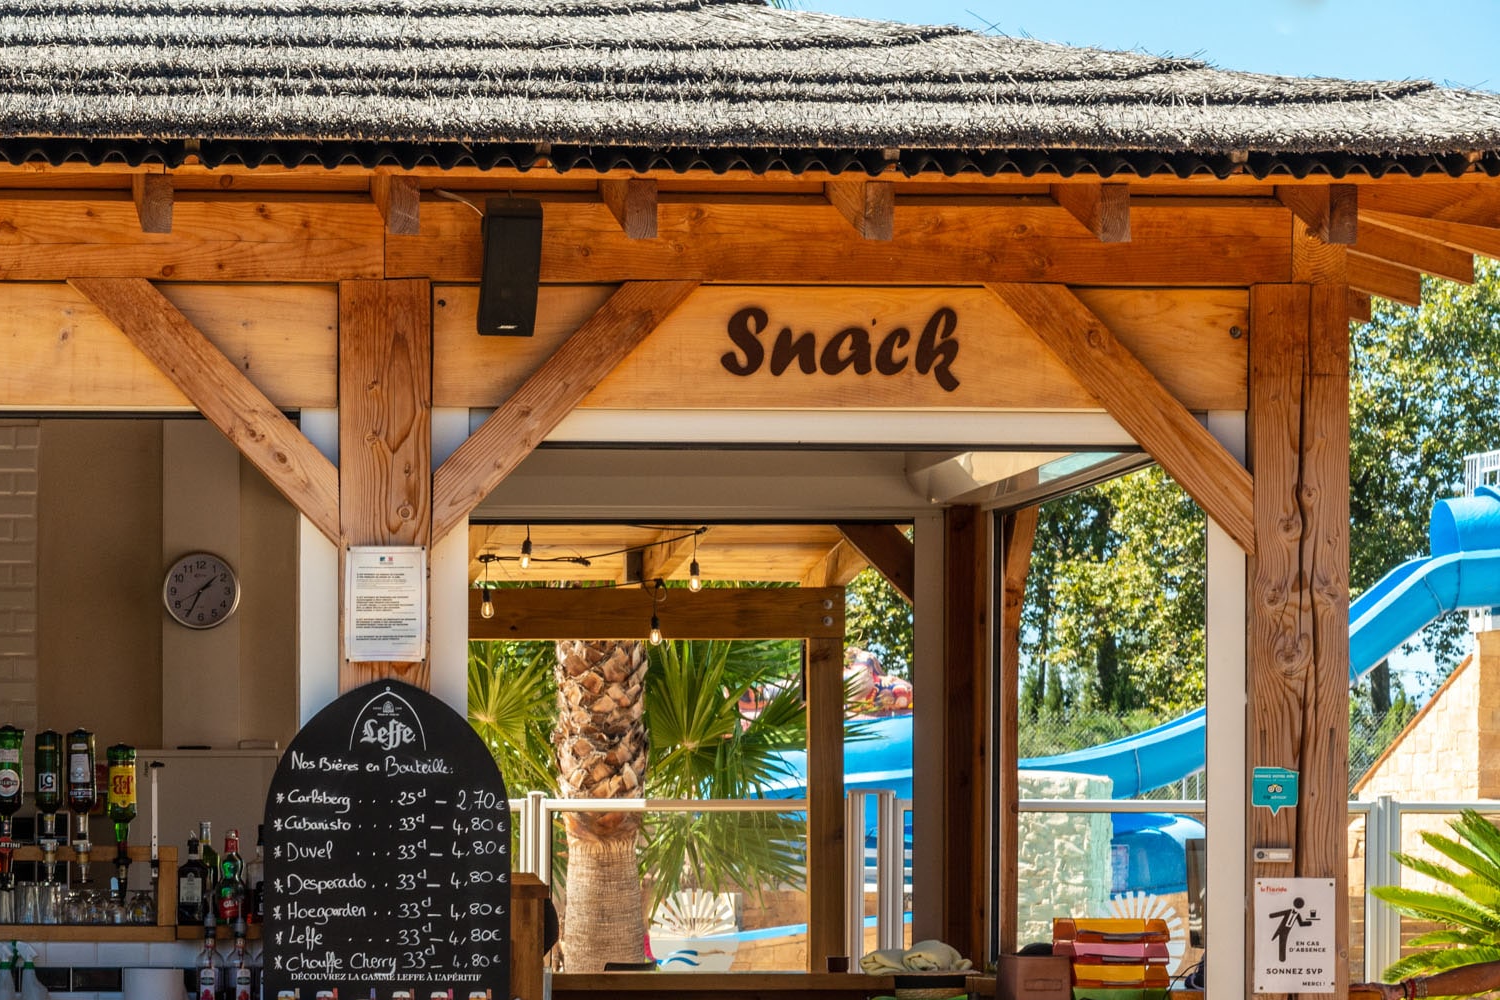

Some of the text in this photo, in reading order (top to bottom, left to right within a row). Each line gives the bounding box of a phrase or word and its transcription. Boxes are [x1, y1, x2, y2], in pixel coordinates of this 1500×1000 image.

[720, 306, 960, 392] Snack
[183, 564, 193, 573] 11
[196, 560, 206, 569] 12
[213, 564, 216, 573] 1
[174, 573, 184, 583] 10
[220, 573, 227, 582] 2
[170, 587, 177, 596] 9
[224, 586, 231, 596] 3
[174, 600, 181, 609] 8
[219, 599, 226, 608] 4
[197, 612, 204, 621] 6
[211, 608, 218, 617] 5
[360, 718, 416, 751] Leffe
[291, 750, 315, 770] Nos
[365, 763, 380, 772] en
[40, 774, 54, 791] 51
[287, 788, 351, 814] Carlsberg
[284, 815, 352, 831] Cubanisto
[287, 840, 333, 862] Duvel
[287, 872, 367, 895] Desperado
[288, 925, 323, 952] Leffe
[286, 951, 343, 974] Chouffe
[349, 952, 397, 977] Cherry
[291, 971, 346, 981] DÉCOUVREZ
[348, 972, 359, 980] LA
[397, 973, 425, 981] LEFFE
